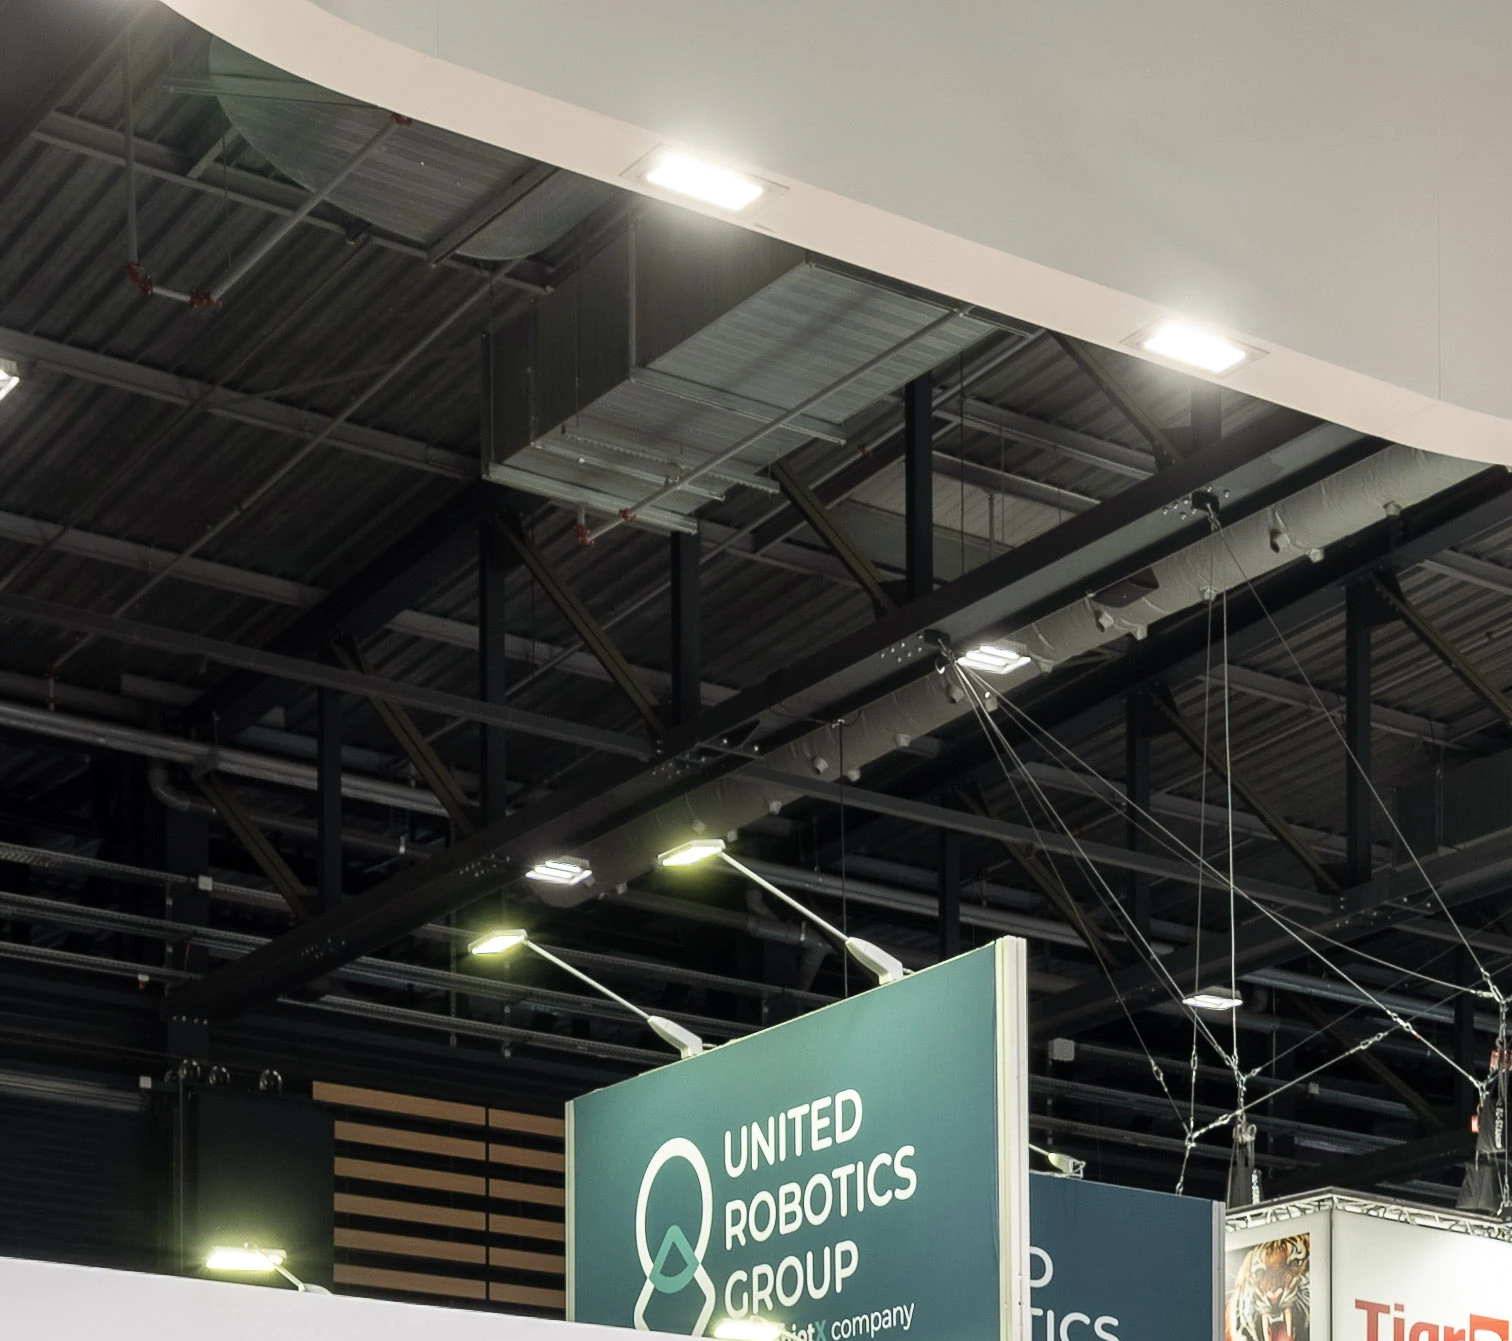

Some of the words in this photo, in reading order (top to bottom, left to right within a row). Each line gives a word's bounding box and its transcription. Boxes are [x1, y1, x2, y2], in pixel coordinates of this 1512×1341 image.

[724, 1088, 863, 1178] UNITED
[724, 1145, 917, 1250] ROBOTICS
[724, 1240, 859, 1320] GROUP
[831, 1302, 915, 1341] company
